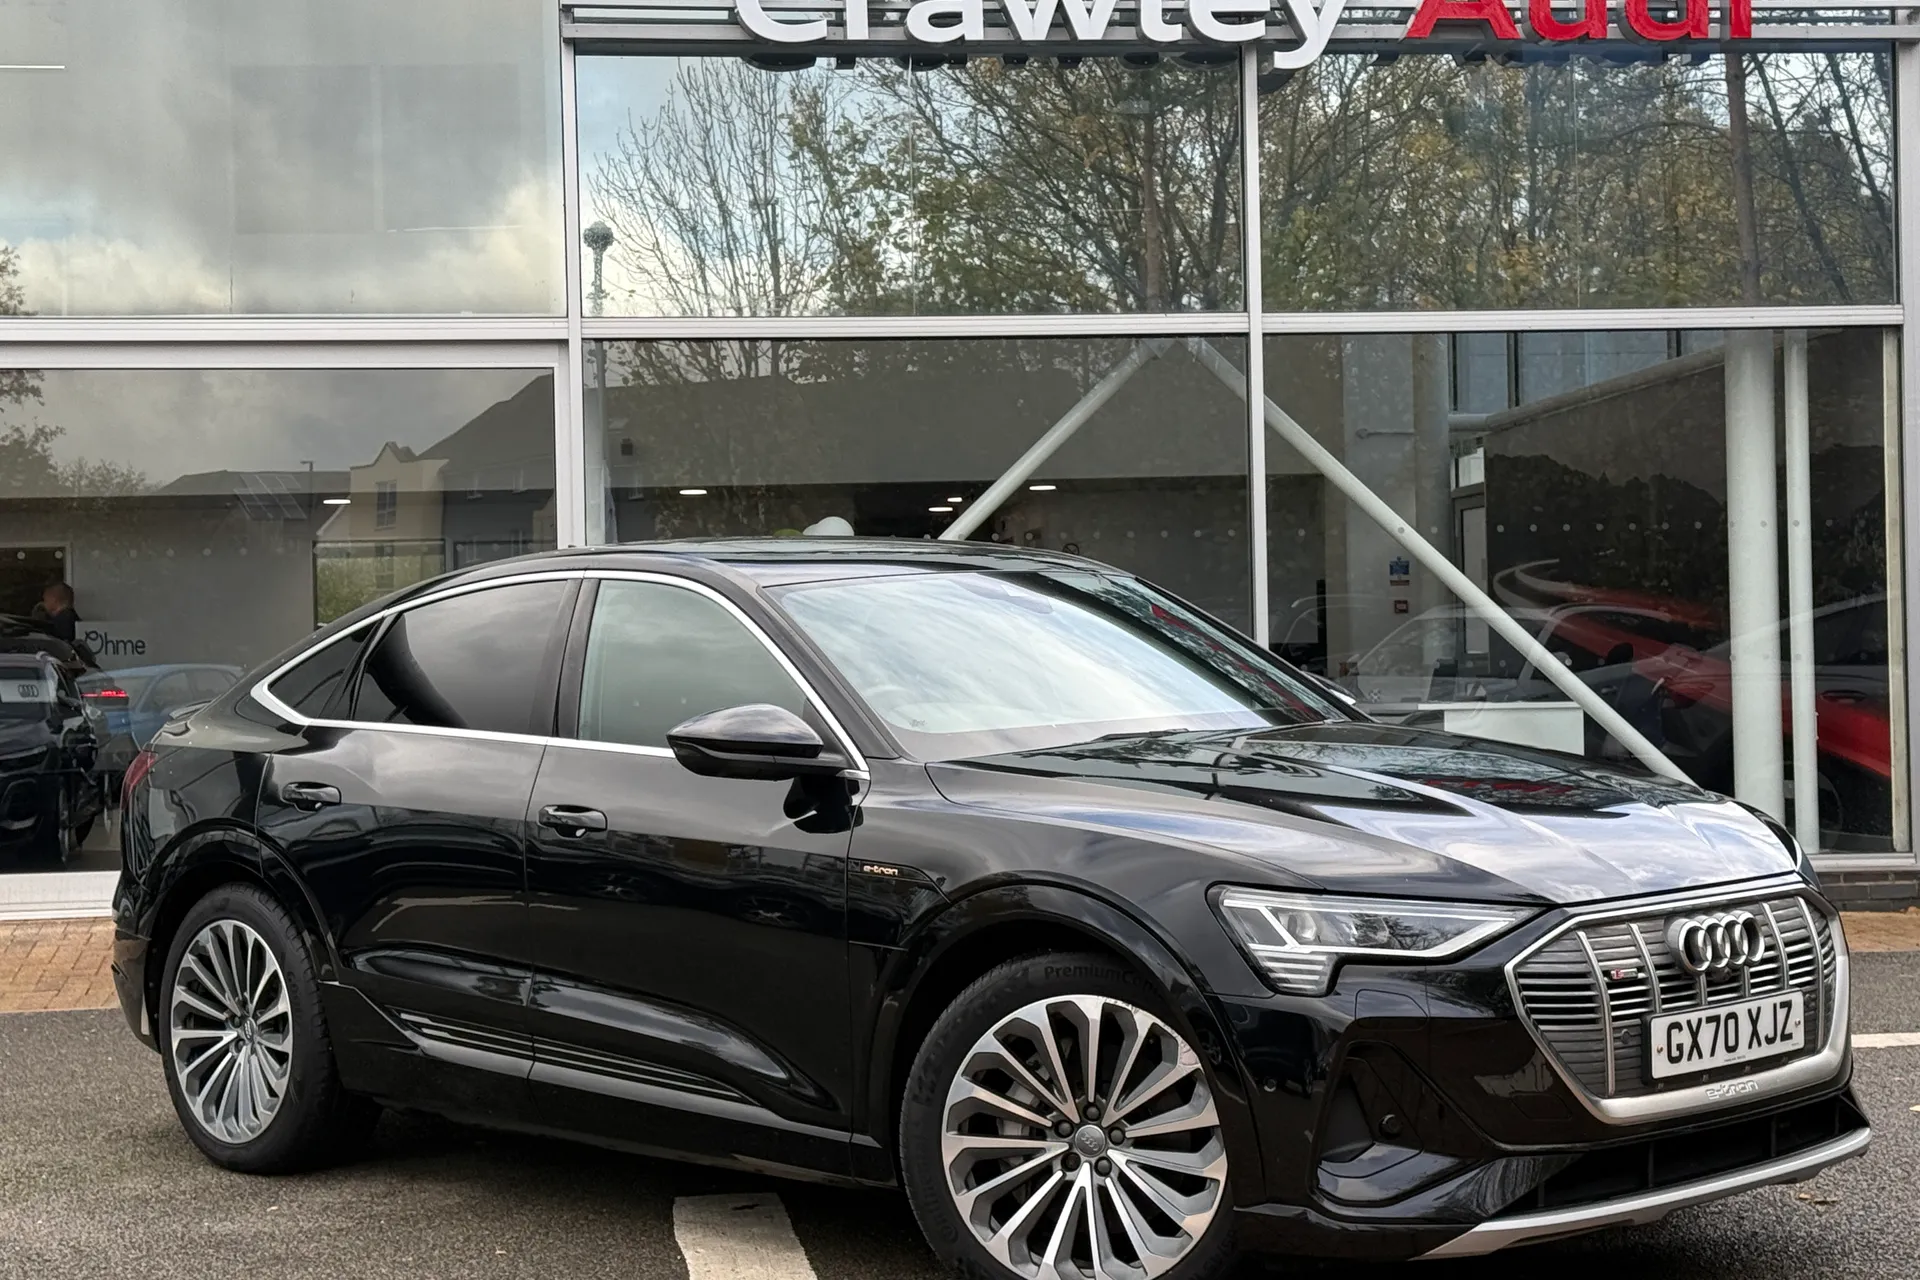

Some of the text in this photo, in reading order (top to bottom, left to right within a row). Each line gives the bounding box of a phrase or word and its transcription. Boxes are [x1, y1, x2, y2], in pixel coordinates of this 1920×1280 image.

[85, 630, 146, 655] Ohme
[863, 865, 898, 875] e-tron
[1667, 1000, 1793, 1064] GX70 XJZ
[1705, 1080, 1759, 1099] e-tron
